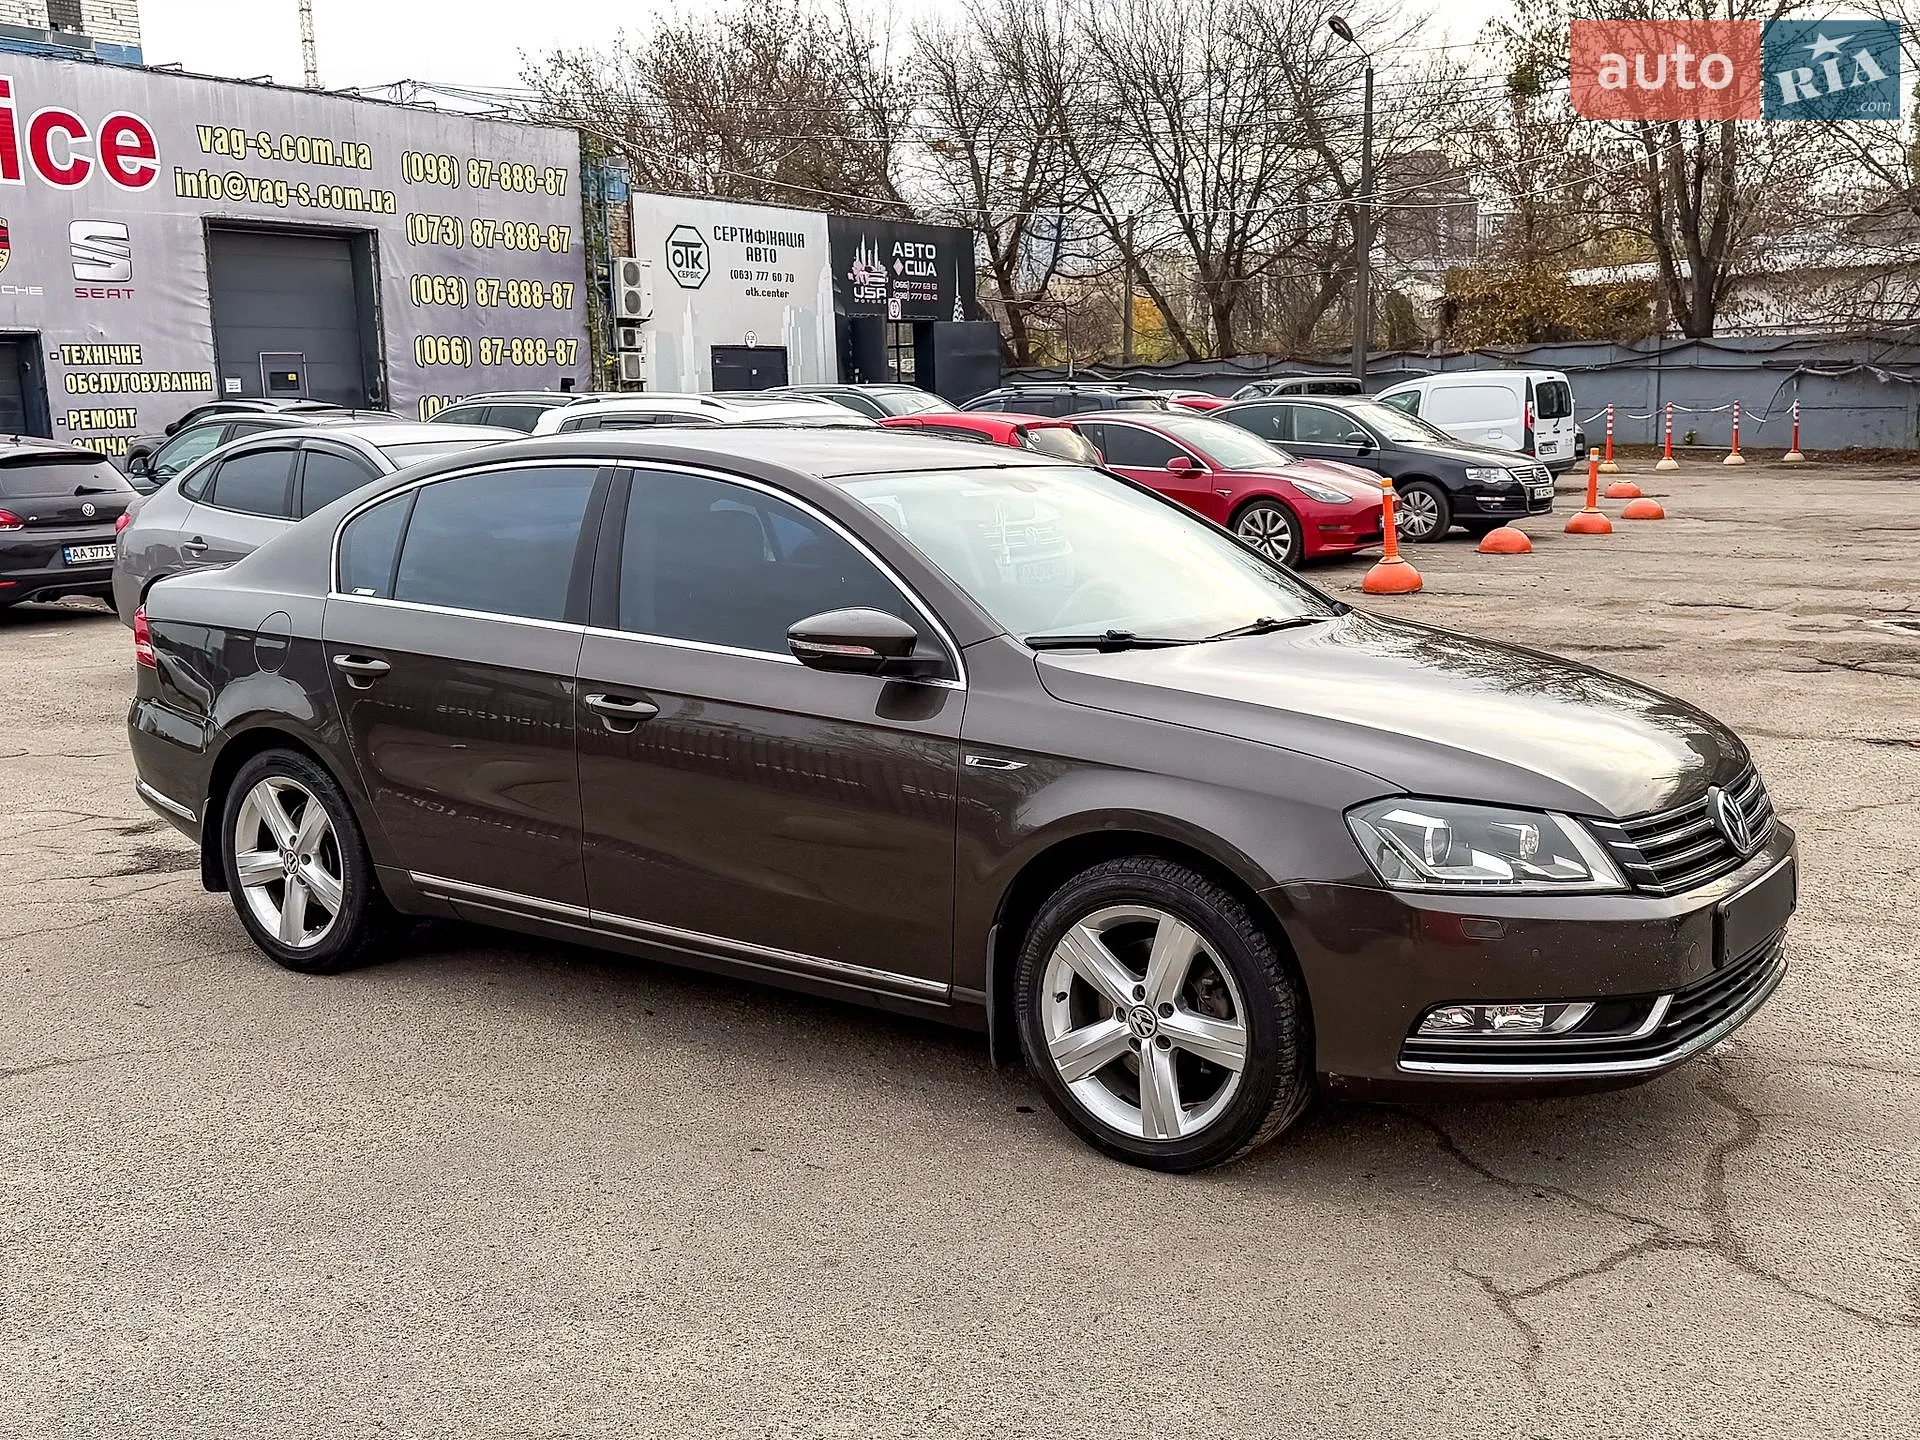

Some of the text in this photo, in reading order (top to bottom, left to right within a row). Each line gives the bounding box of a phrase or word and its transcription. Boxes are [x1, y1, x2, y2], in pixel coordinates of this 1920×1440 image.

[196, 125, 372, 170] vag-s.com.ua
[401, 151, 568, 196] (098) 87-888-87
[174, 167, 396, 214] info@vag-s.com.ua
[405, 213, 571, 253] (073) 87-888-87
[713, 225, 805, 248] СЕРТИФІКАЦІЯ
[746, 247, 777, 264] АВТО
[892, 241, 937, 260] АВТО
[677, 270, 701, 280] СЕРВІС
[730, 269, 795, 283] (063) 777 60 70
[904, 260, 937, 277] США
[75, 288, 135, 299] SEAT
[410, 274, 574, 309] (063) 87-888-87
[745, 287, 790, 299] otk.center
[853, 285, 887, 299] USA
[60, 344, 142, 365] ТЕХНІЧНЕ
[414, 335, 578, 368] (066) 87-888-87
[65, 372, 213, 394] ОБСЛУГОВУВАННЯ
[67, 408, 137, 430] РЕМОНТ
[88, 546, 110, 558] 3773
